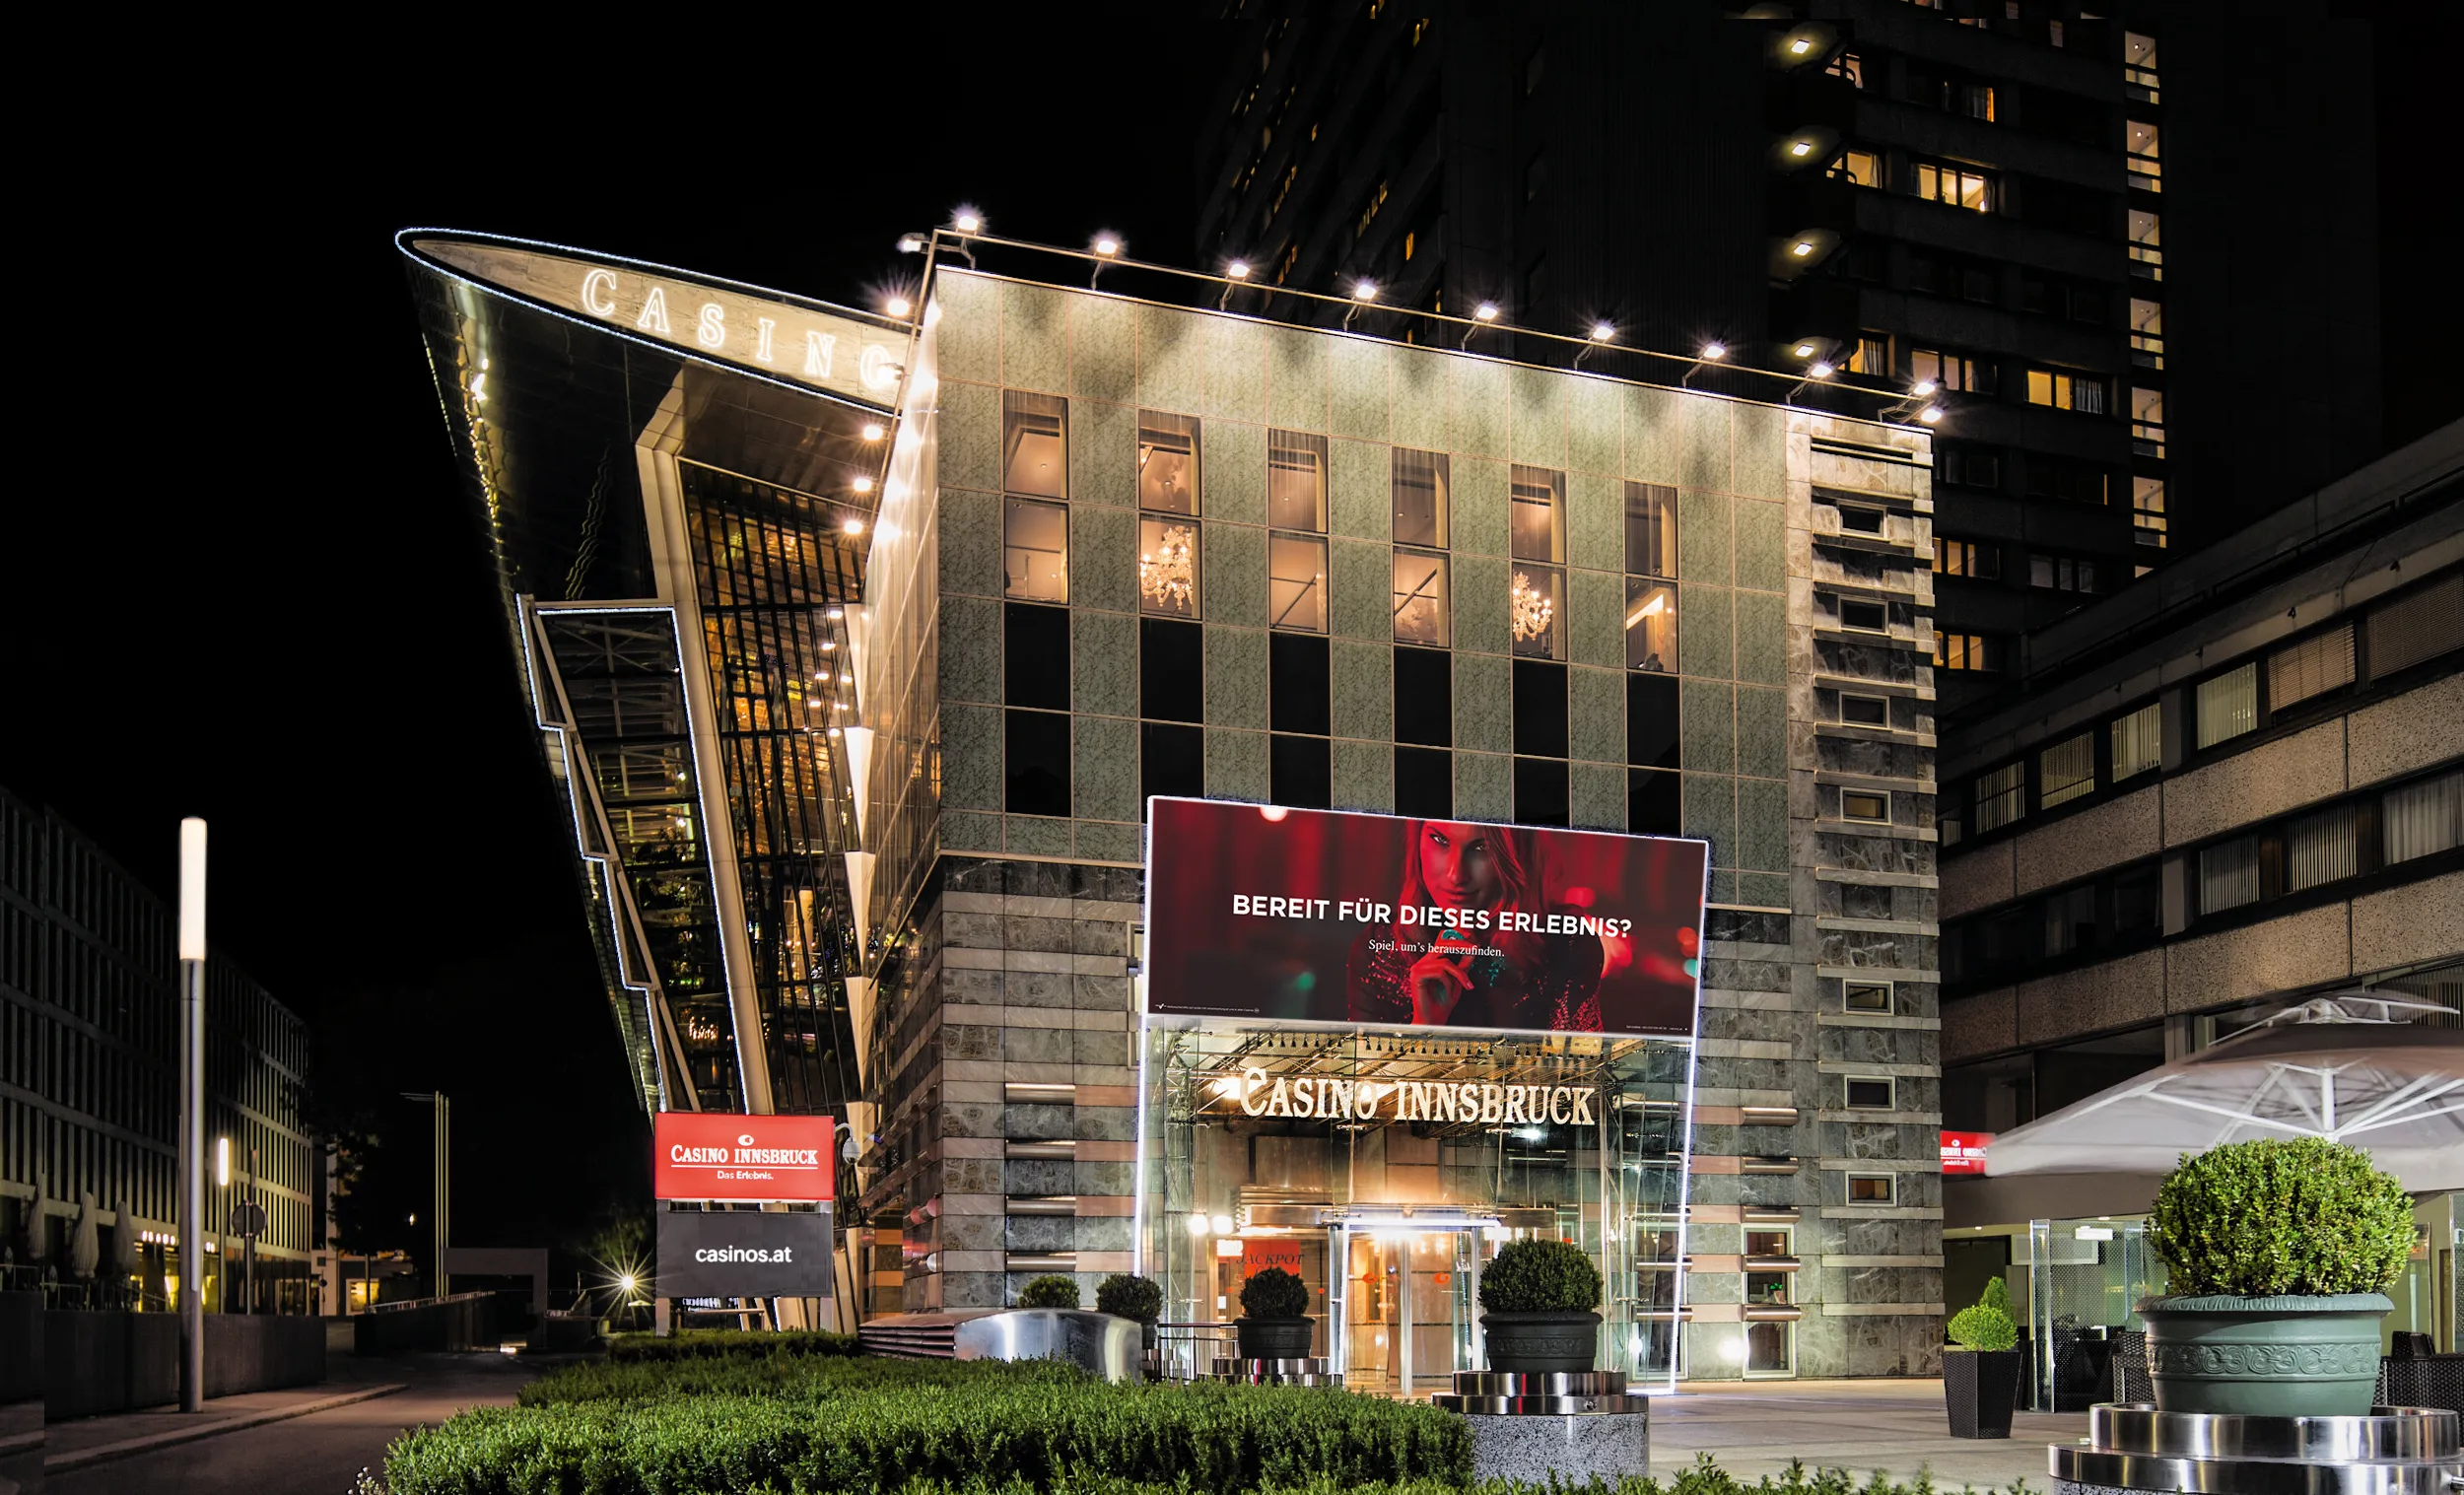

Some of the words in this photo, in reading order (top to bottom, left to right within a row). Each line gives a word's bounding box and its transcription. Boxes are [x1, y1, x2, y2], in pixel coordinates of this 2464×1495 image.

[582, 269, 895, 390] CASINO
[1232, 894, 1331, 919] BEREIT
[1337, 897, 1392, 924] FÜR
[1400, 905, 1490, 930] DIESES
[1498, 911, 1632, 938] ERLEBNIS?
[1368, 939, 1399, 952] Spiel,
[1401, 942, 1425, 952] um's
[1427, 942, 1505, 957] herauszufinden.
[1239, 1066, 1378, 1121] CASINO
[1394, 1081, 1596, 1125] INNSBRUCK
[670, 1144, 728, 1164] CASINO
[733, 1148, 819, 1165] INNSBRUCK
[717, 1170, 734, 1180] Das
[736, 1170, 774, 1181] Erlebnis.
[695, 1244, 792, 1263] casinos.at
[1236, 1253, 1306, 1265] JACKPOT
